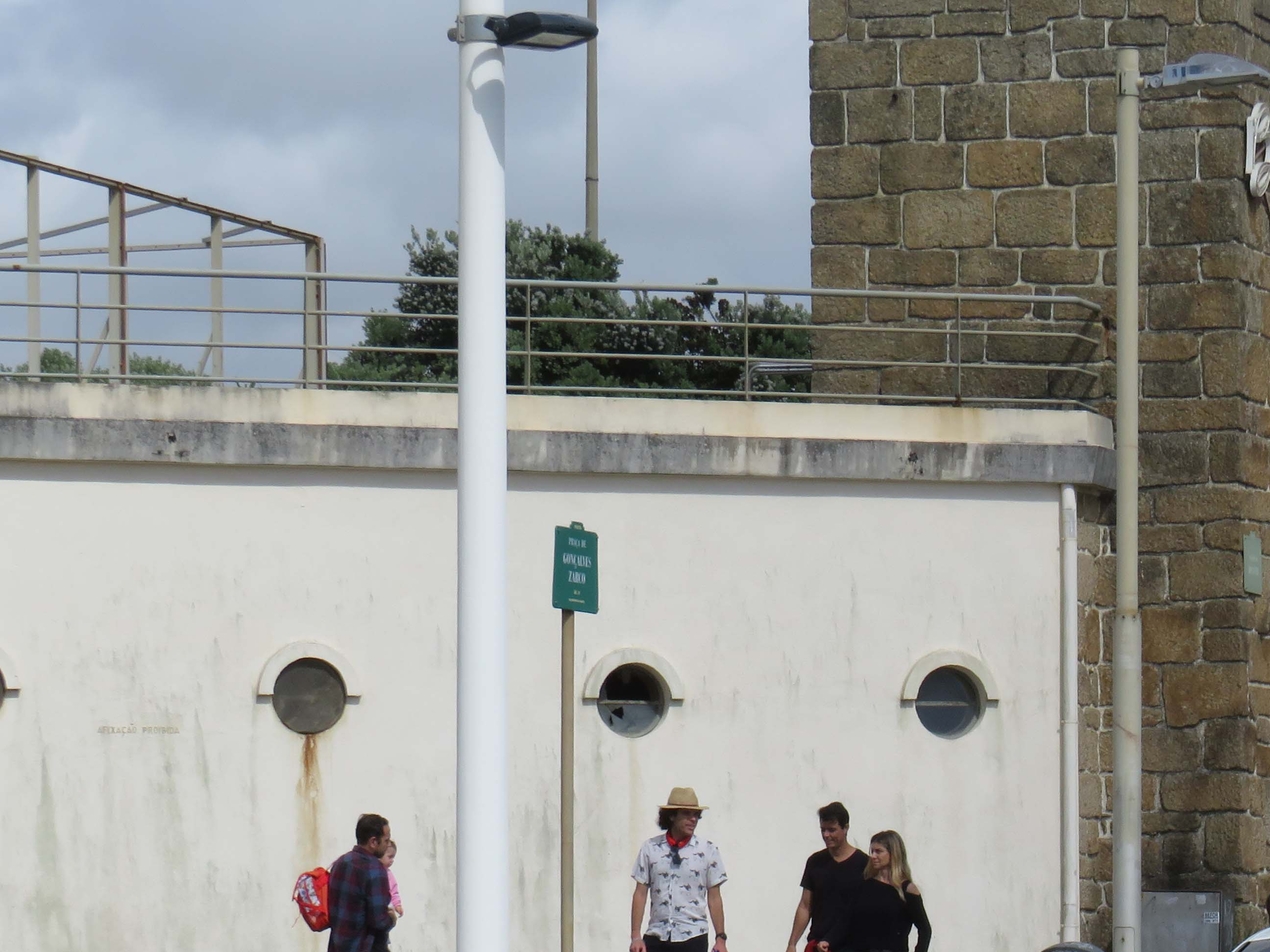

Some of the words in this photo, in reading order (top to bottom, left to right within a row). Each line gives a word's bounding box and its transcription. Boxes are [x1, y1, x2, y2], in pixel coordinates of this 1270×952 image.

[581, 539, 587, 548] DE
[562, 552, 592, 568] GONÇALVES
[568, 570, 586, 585] ZARCO
[97, 723, 138, 736] AFIXAÇÃO
[142, 726, 180, 735] PROIBIDA
